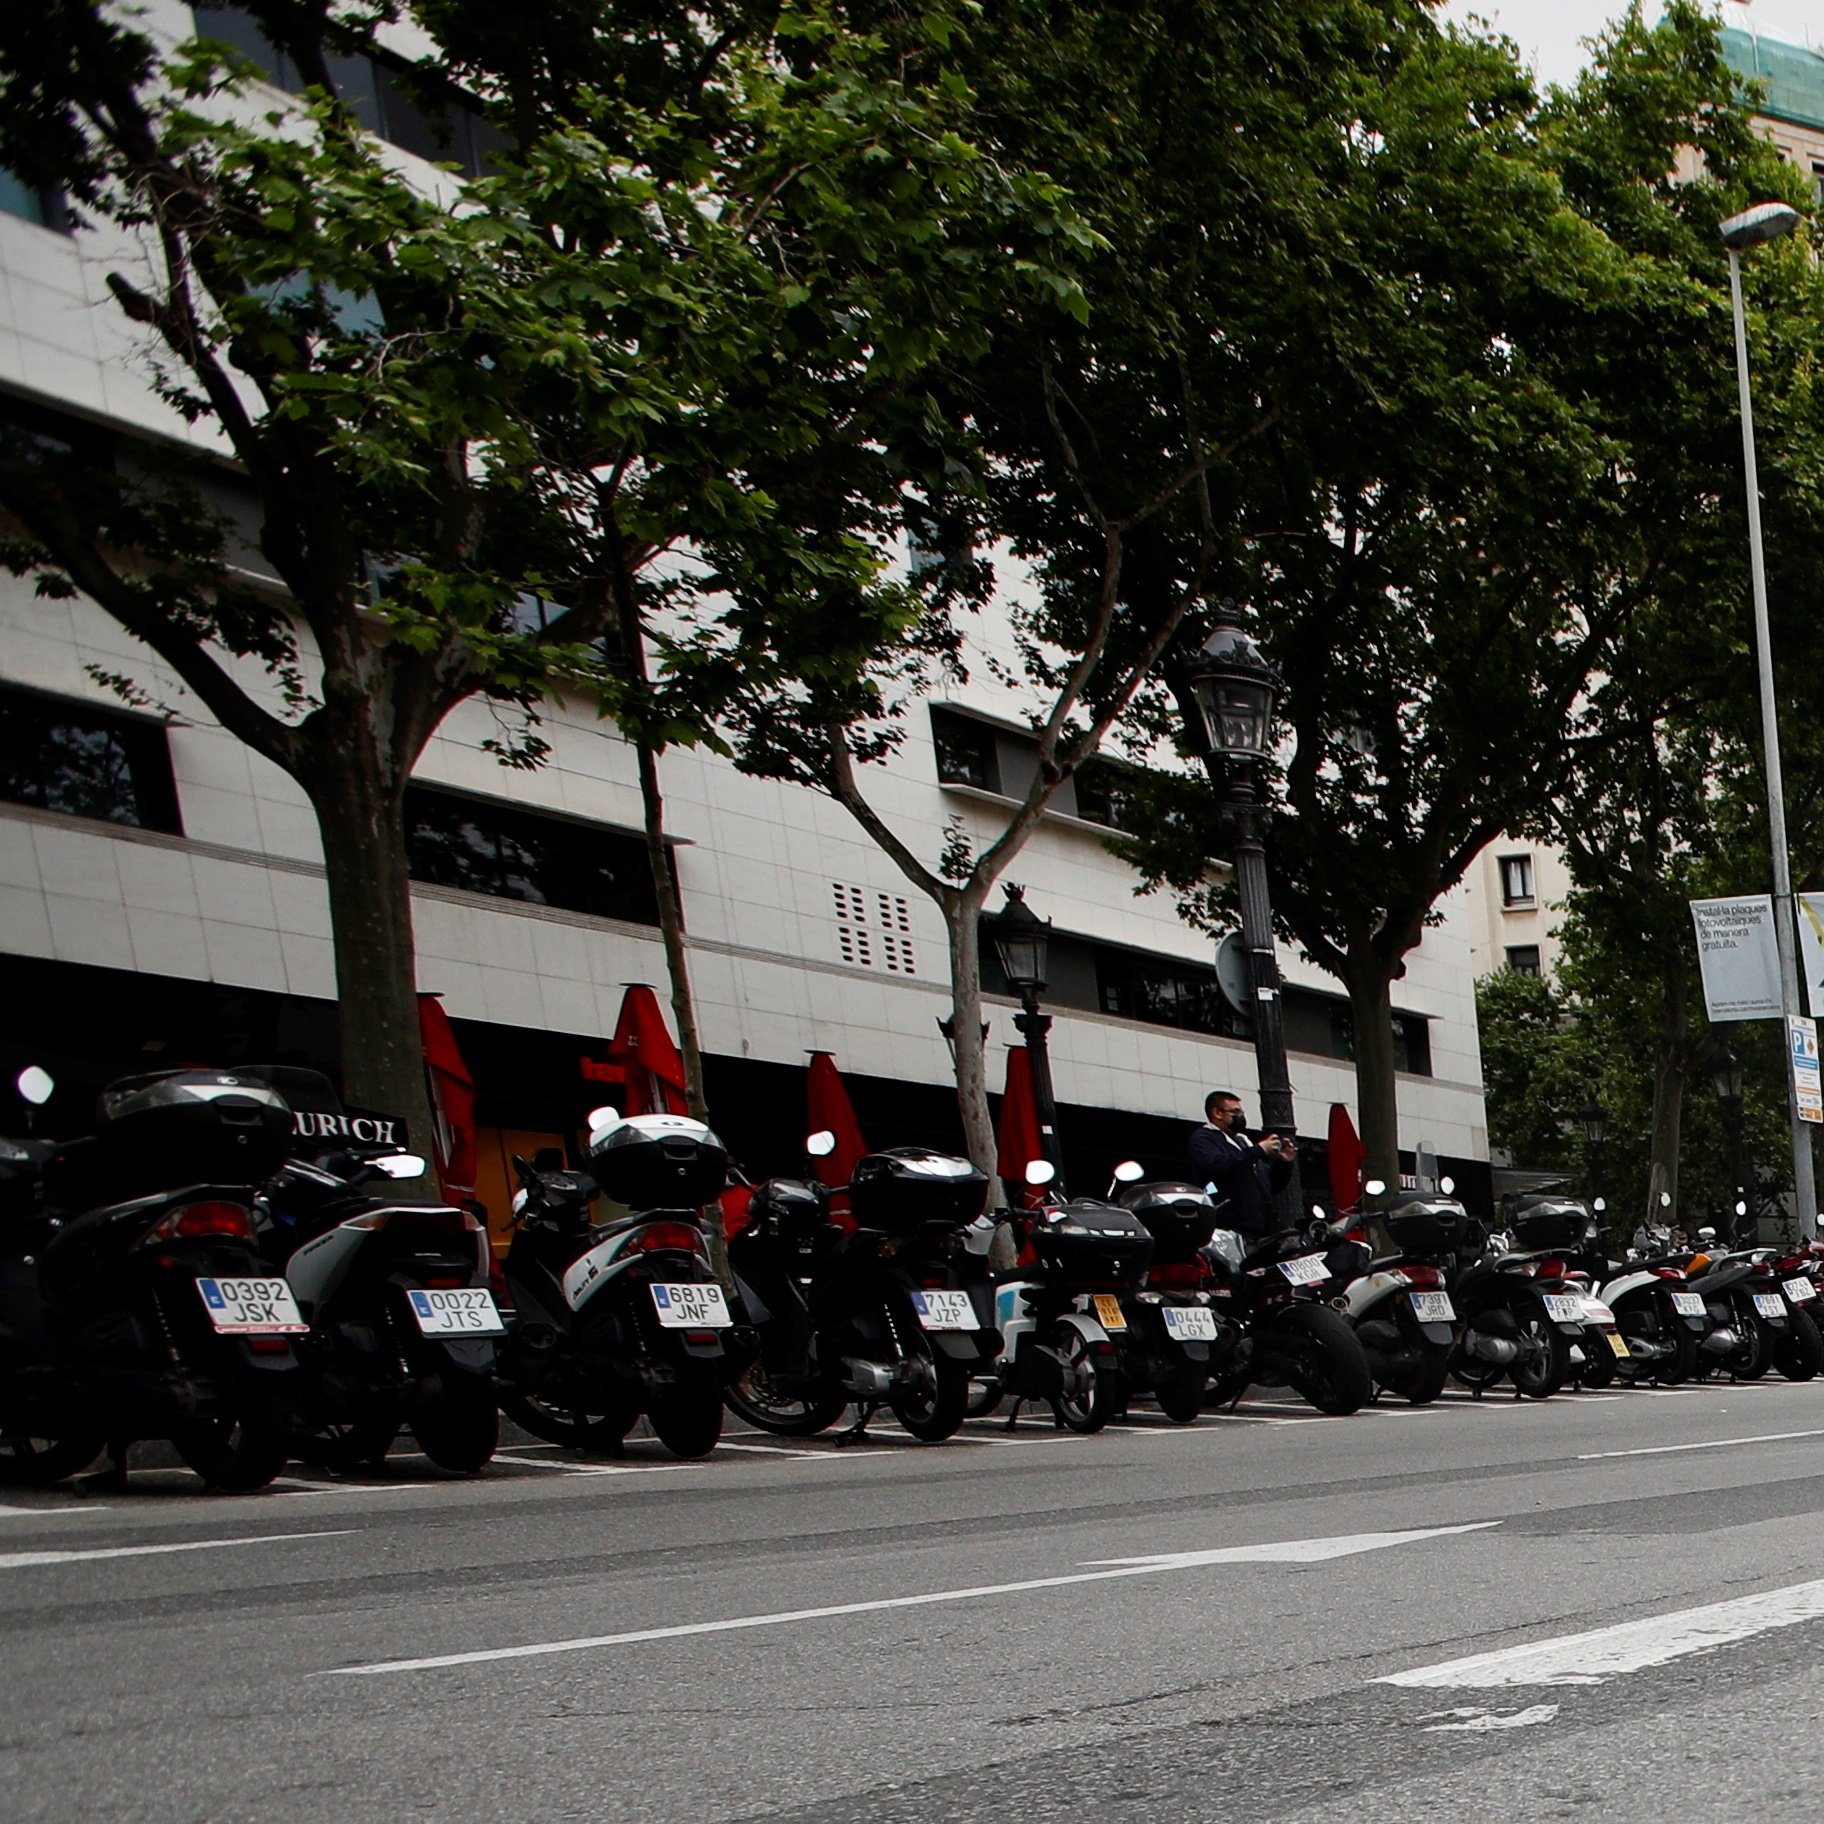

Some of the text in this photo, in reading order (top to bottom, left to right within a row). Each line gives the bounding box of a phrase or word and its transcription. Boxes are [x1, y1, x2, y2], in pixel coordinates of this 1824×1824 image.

[1731, 904, 1768, 916] plaques
[1700, 927, 1750, 939] de manera
[292, 1111, 397, 1145] URICH
[221, 1281, 288, 1301] 0392
[669, 1287, 719, 1303] 6819
[430, 1292, 491, 1310] 0022
[925, 1294, 967, 1307] 7143
[234, 1303, 281, 1323] JSK
[441, 1311, 483, 1328] JTS
[676, 1304, 709, 1320] JNF
[935, 1309, 961, 1322] JZP
[1175, 1312, 1210, 1323] 0444
[1178, 1324, 1206, 1336] LGX
